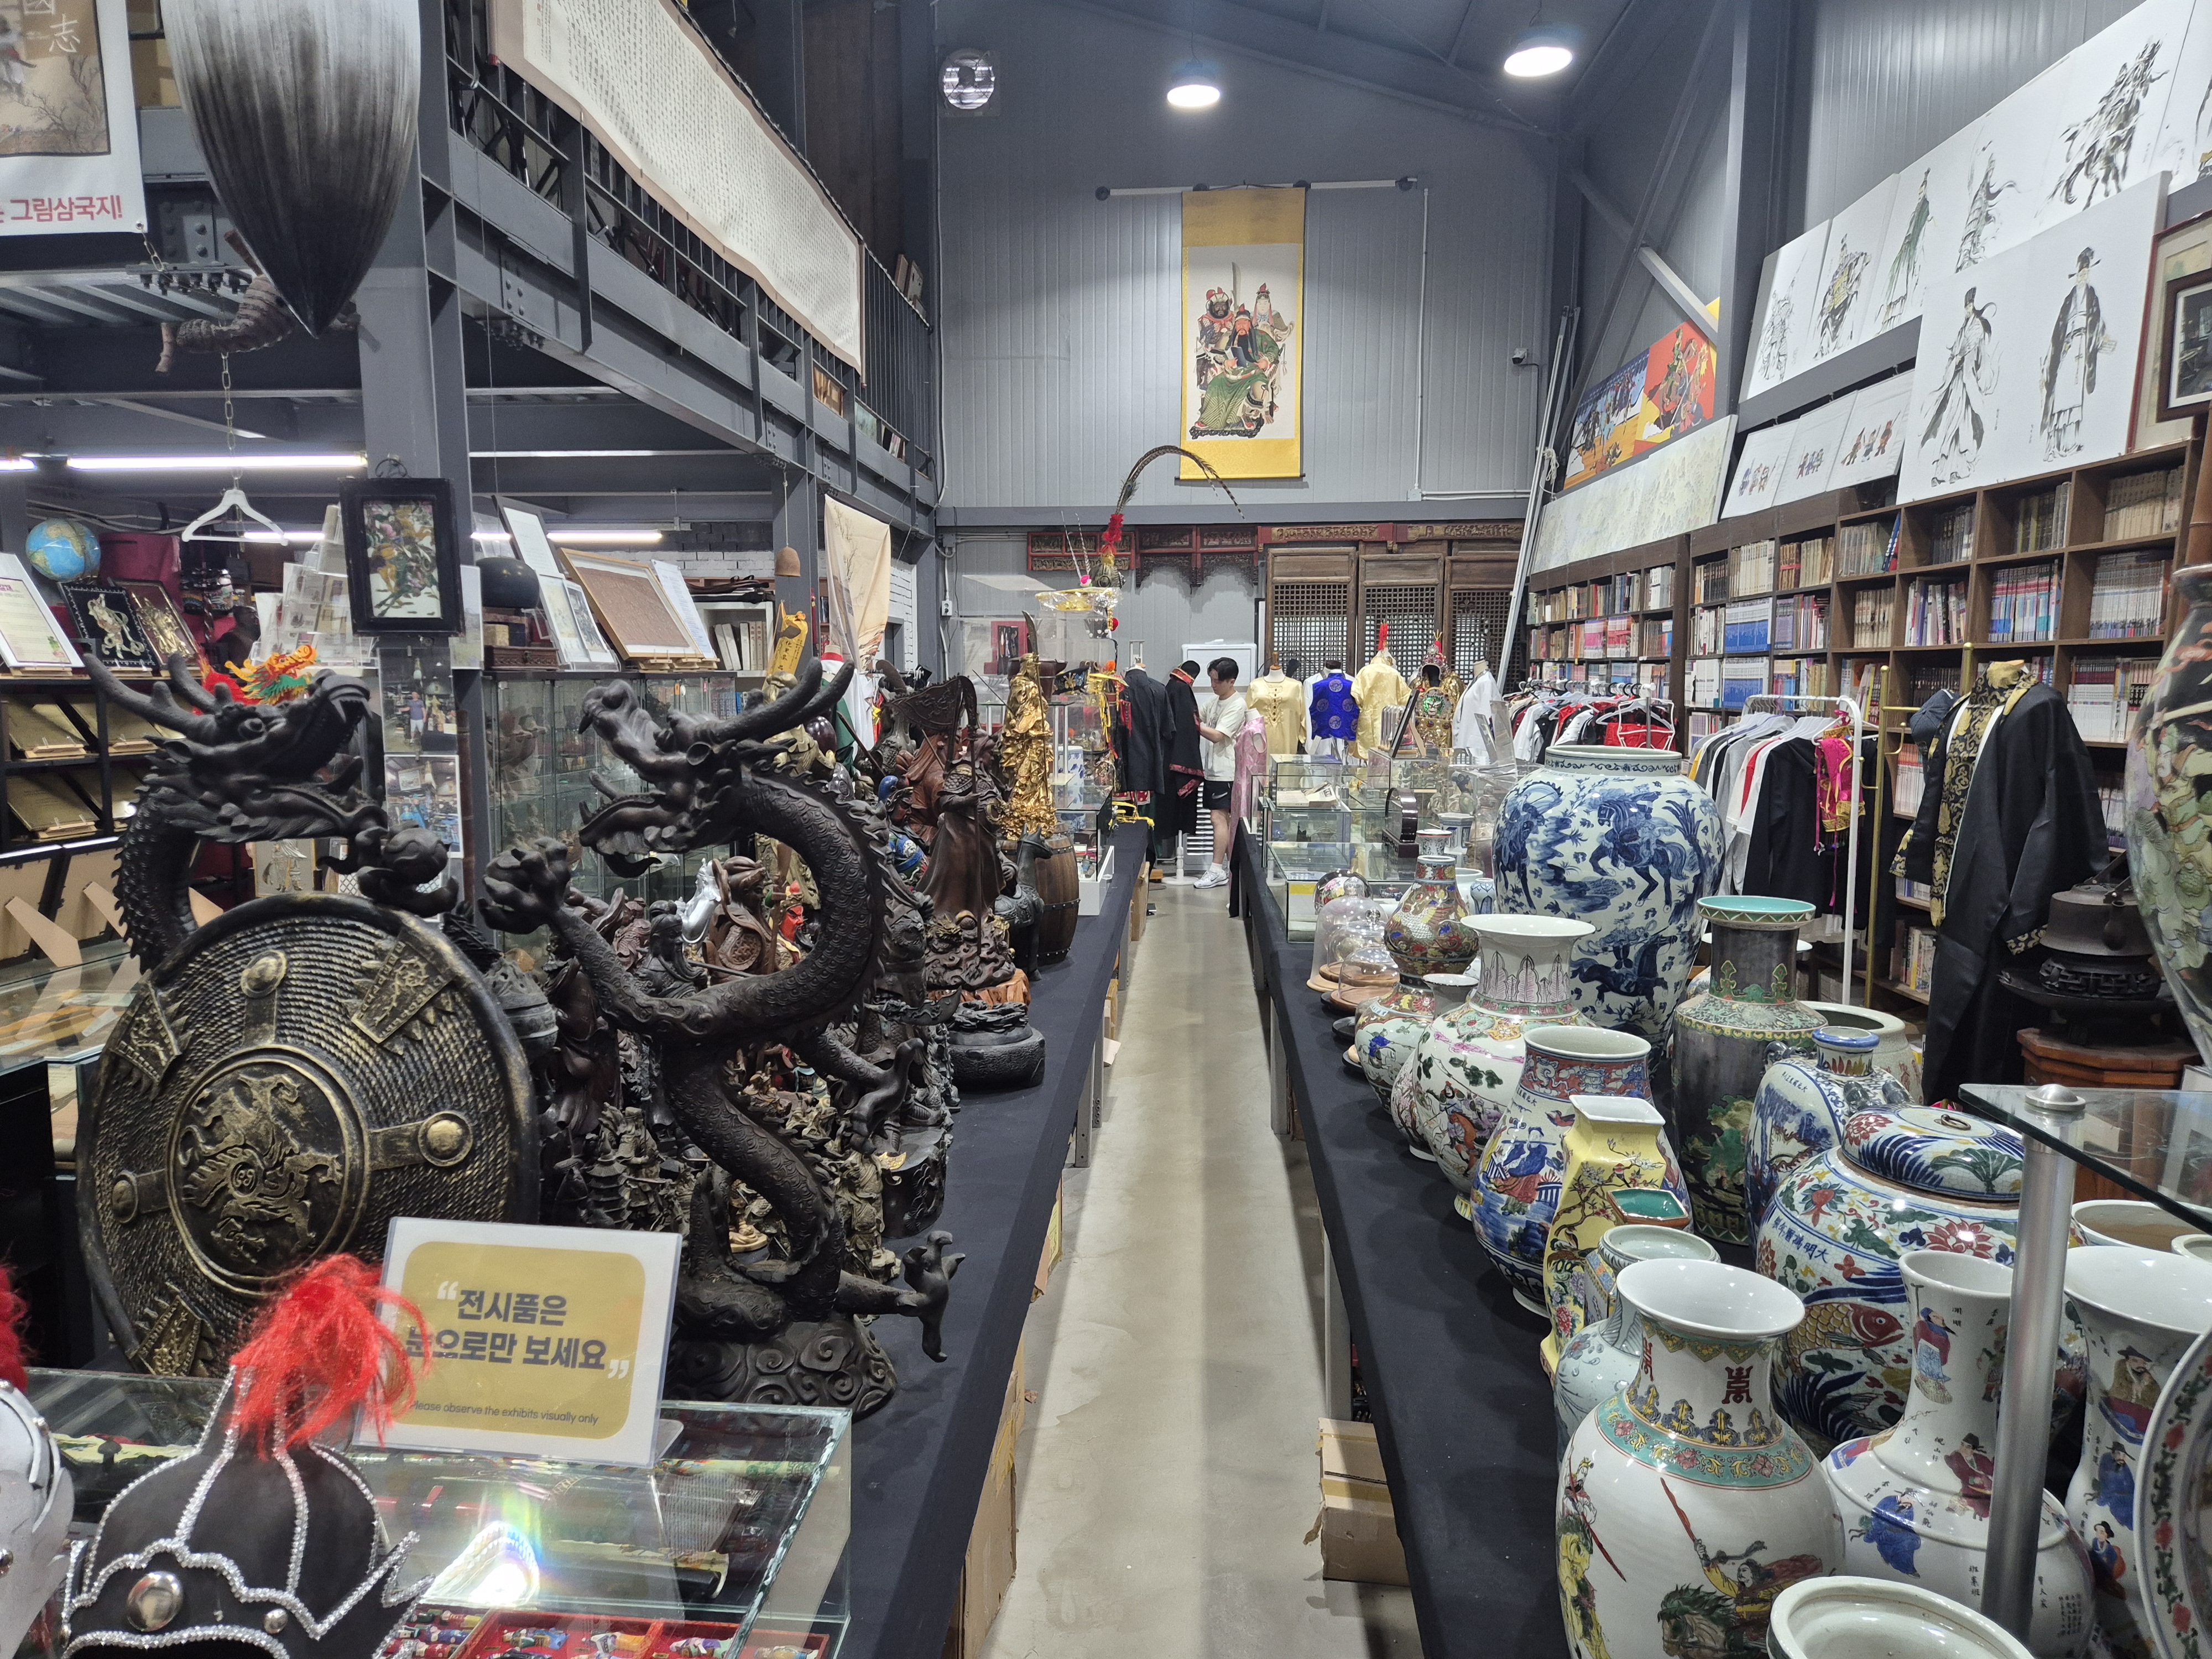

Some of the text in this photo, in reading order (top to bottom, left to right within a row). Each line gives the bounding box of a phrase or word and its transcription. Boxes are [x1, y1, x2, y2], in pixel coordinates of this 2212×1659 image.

[10, 195, 123, 222] 그림삼국지!
[405, 1327, 518, 1364] 눈으로만
[443, 1402, 483, 1415] observe
[484, 1406, 500, 1416] the
[502, 1408, 539, 1420] exhibits
[540, 1411, 577, 1425] visually
[578, 1413, 599, 1426] only
